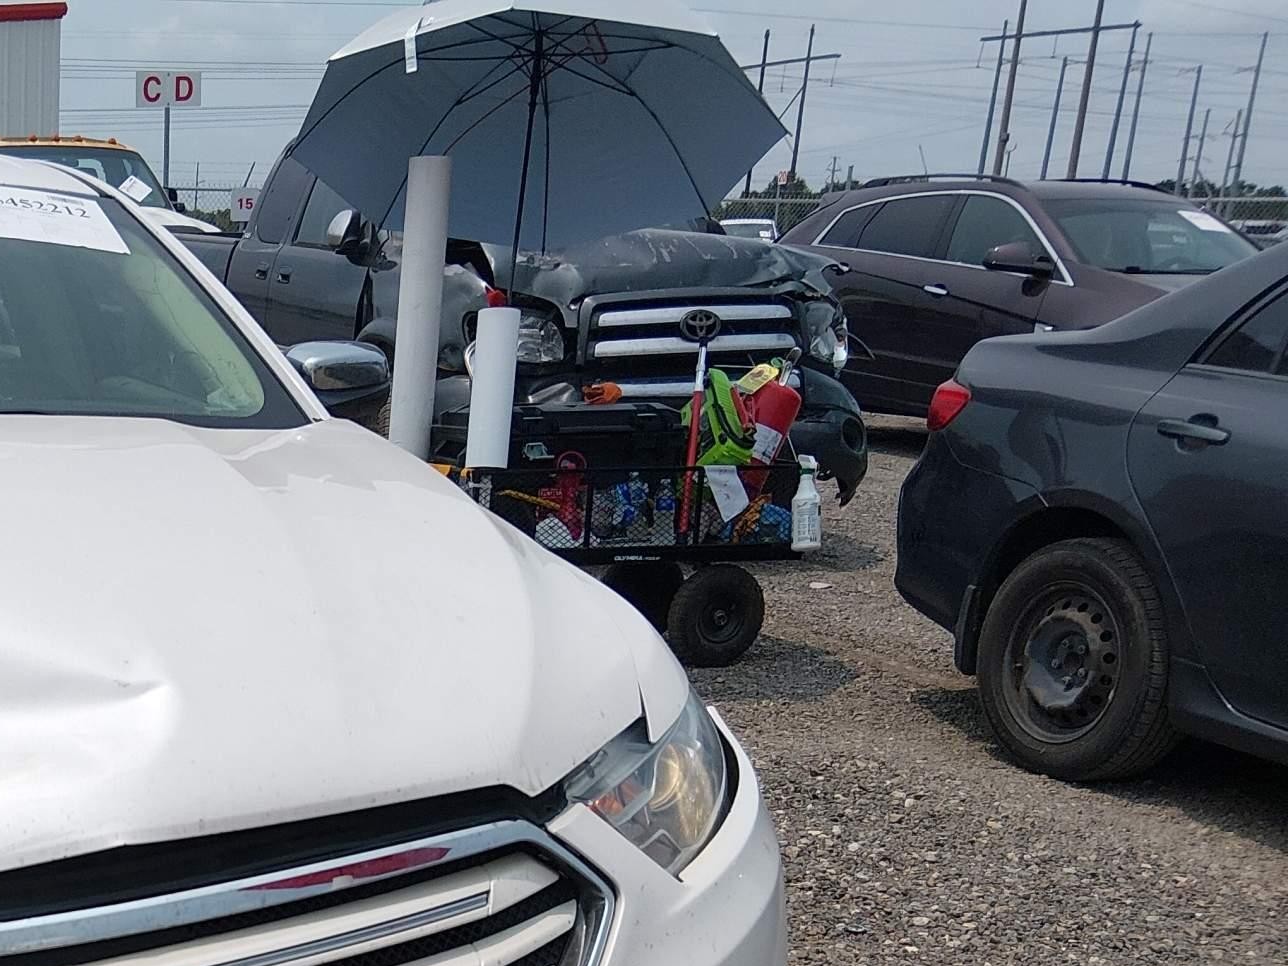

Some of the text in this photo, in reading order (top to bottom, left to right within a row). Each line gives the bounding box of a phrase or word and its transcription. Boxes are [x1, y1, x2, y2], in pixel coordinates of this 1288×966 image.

[143, 76, 194, 103] C D
[237, 197, 254, 211] 15
